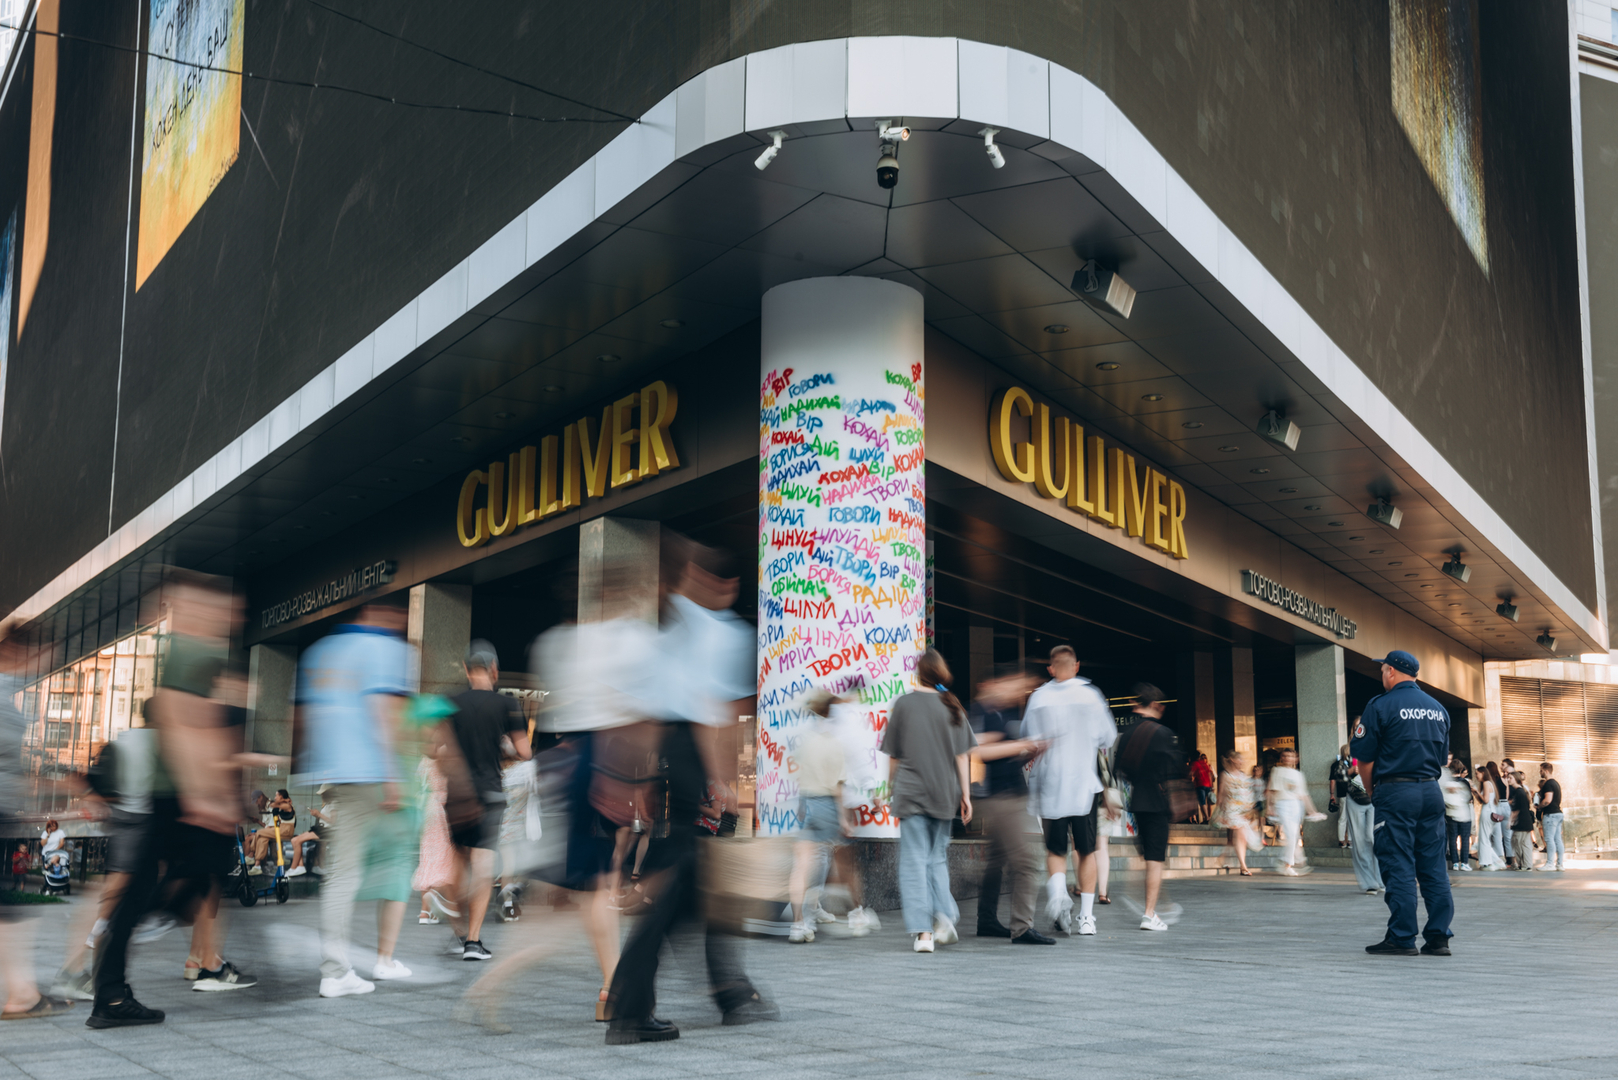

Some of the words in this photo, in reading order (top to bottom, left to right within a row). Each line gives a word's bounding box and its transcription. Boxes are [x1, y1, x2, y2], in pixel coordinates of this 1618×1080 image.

[772, 367, 794, 398] ВІР
[788, 373, 834, 398] ГОВОРИ
[780, 395, 841, 422] НАДИХАЙ
[771, 428, 805, 445] КОХАЙ
[844, 415, 889, 452] КОХАЙ
[769, 442, 812, 473] БОРИСЯ
[810, 434, 840, 461] ДІЙ
[456, 380, 681, 548] GULLIVER
[767, 452, 820, 492] НАДИХАЙ
[818, 462, 870, 485] КОХАЙ
[990, 386, 1188, 560] GULLIVER
[821, 474, 880, 505] НАДИХАЙ
[863, 478, 910, 504] ТВОРИ
[767, 505, 805, 527] КОХАЙ
[829, 505, 881, 526] ГОВОРИ
[771, 527, 817, 555] ЦІНУЙ
[854, 538, 881, 565] ДІЙ
[890, 541, 921, 562] ТВОРИ
[765, 550, 806, 582] ТВОРИ
[811, 546, 834, 567] ДІЙ
[835, 545, 877, 587] ТВОРИ
[880, 561, 900, 579] ВІР
[808, 564, 852, 595] БОРИСЯ
[261, 569, 357, 629] ТОРГОВО-РОЗВАЖАЛЬНИЙ
[357, 560, 388, 595] ЦЕНТР
[784, 595, 836, 619] ЦІЛУЙ
[1241, 569, 1340, 633] ТОРГОВО-РОЗВАЖАЛЬНИЙ
[1338, 614, 1358, 639] ЦЕНТР
[838, 604, 874, 631] ДІЙ
[798, 624, 857, 649] ЦІНУЙ
[864, 623, 912, 645] КОХАЙ
[779, 639, 816, 673] МРІЙ
[806, 643, 869, 677] ТВОРИ
[873, 643, 898, 658] ВІР
[866, 655, 890, 679] ВІР
[857, 673, 907, 706] ЦІЛУЙ
[1399, 708, 1445, 722] ОХОРОНА
